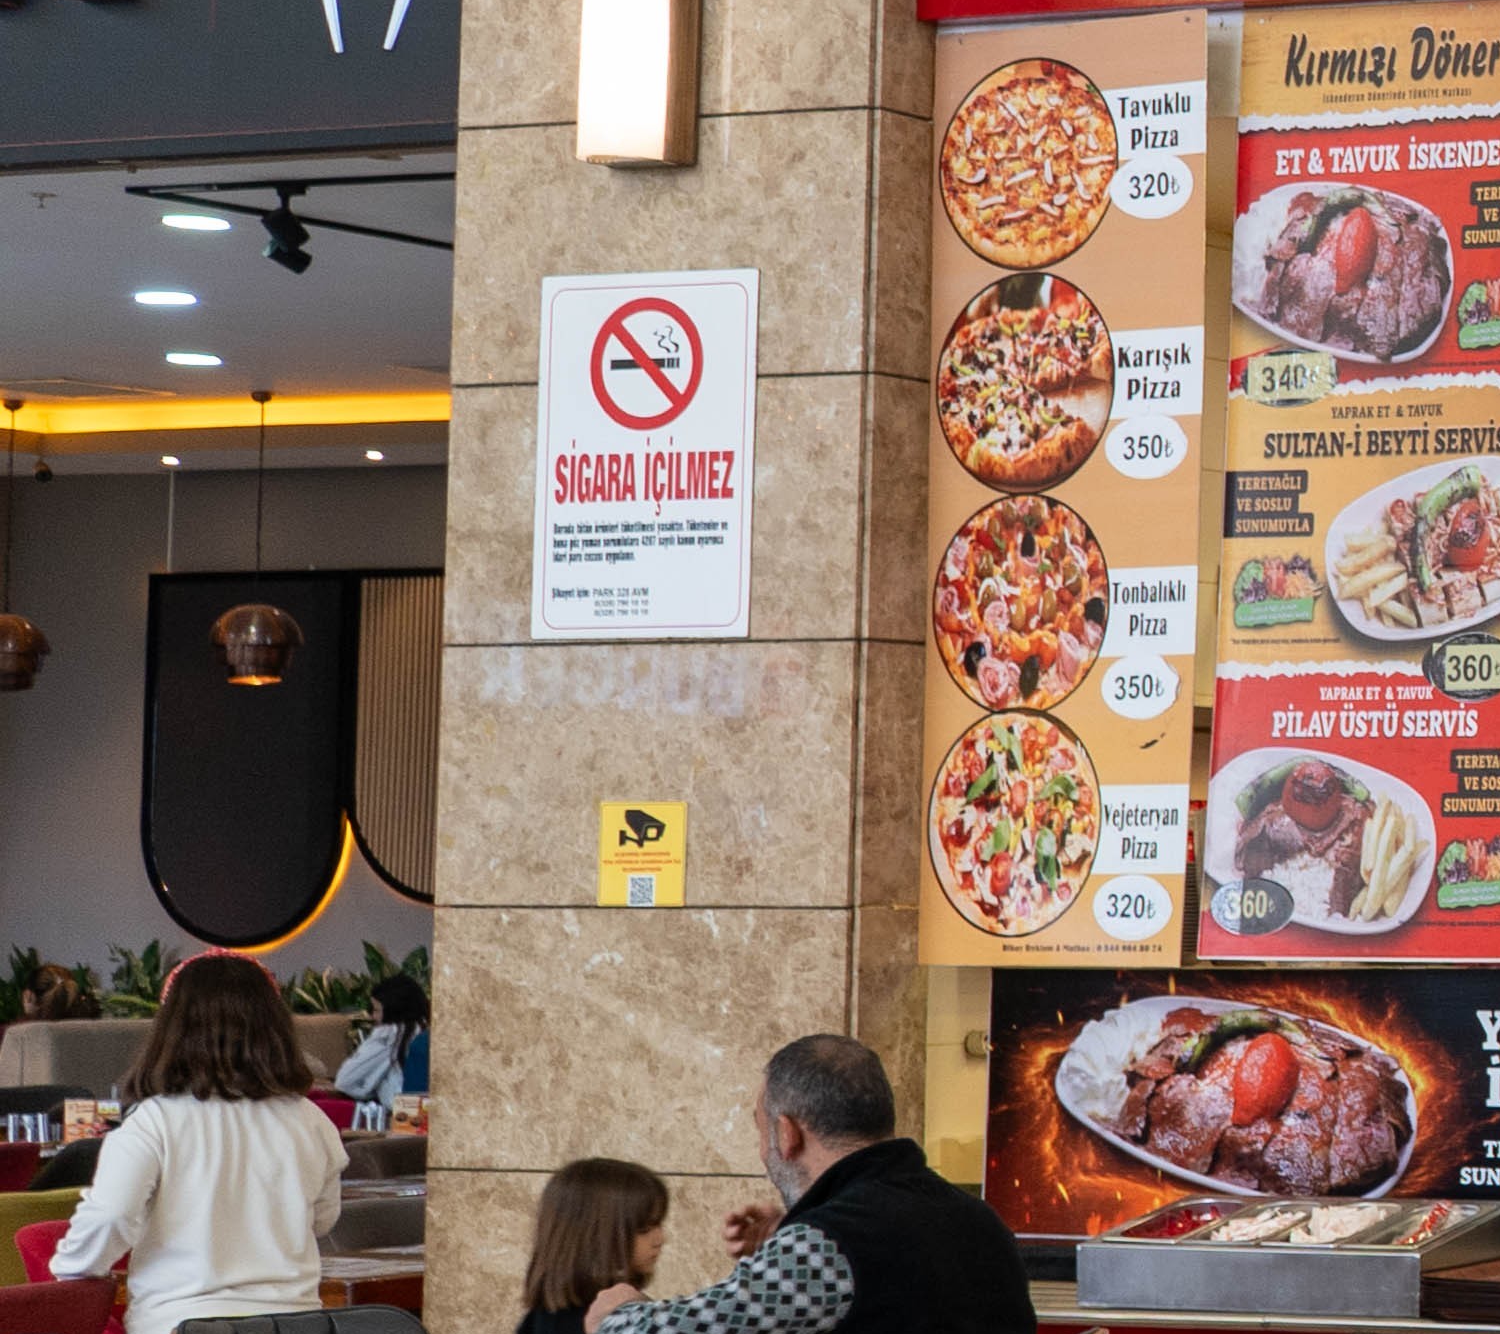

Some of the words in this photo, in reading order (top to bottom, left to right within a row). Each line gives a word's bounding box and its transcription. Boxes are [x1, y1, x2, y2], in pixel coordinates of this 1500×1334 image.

[1285, 33, 1397, 88] Kırmızı
[1119, 94, 1191, 119] Tavuklu
[1130, 125, 1179, 150] Pizza
[1275, 148, 1304, 176] ET
[1307, 148, 1325, 175] &
[1329, 145, 1400, 173] TAVUK
[1483, 208, 1499, 222] VE
[1118, 341, 1192, 372] Karışık
[1127, 377, 1181, 402] Pizza
[1331, 406, 1374, 419] YAPRAK
[1377, 405, 1391, 417] ET
[1407, 404, 1443, 417] TAVUK
[1264, 424, 1361, 458] SULTAN-İ
[1367, 422, 1429, 456] BEYTİ
[555, 439, 636, 504] SİGARA
[644, 436, 735, 516] İÇİLMEZ
[1236, 498, 1252, 511] VE
[1254, 497, 1292, 511] SOSLU
[1235, 518, 1310, 533] SUNUMUYLA
[1112, 579, 1187, 607] Tonbalıklı
[1128, 612, 1168, 638] Pizza
[1320, 687, 1363, 701] YAPRAK
[1366, 687, 1380, 700] ET
[1385, 686, 1394, 700] &
[1397, 686, 1433, 699] TAVUK
[1272, 704, 1333, 738] PİLAV
[1339, 703, 1398, 737] ÜSTÜ
[1403, 703, 1479, 737] SERVİS
[1464, 777, 1479, 791] VE
[1103, 801, 1179, 829] Vejeteryan
[1120, 836, 1158, 861] Pizza
